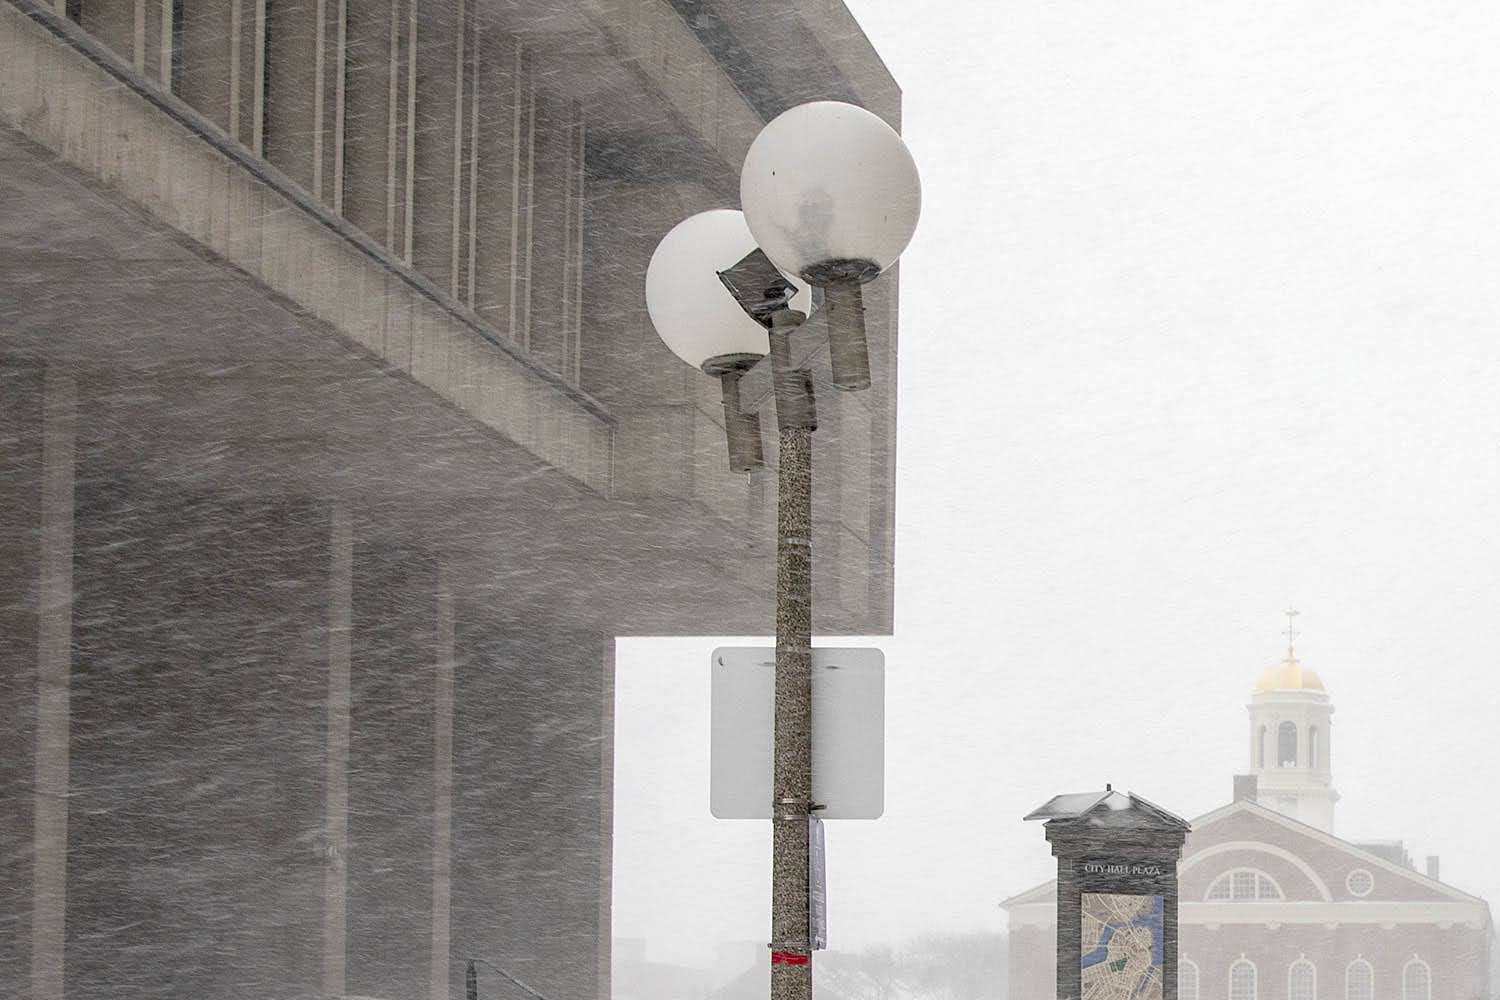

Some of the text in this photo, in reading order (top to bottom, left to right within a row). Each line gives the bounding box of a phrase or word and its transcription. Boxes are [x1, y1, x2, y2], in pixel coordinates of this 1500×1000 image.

[1084, 864, 1161, 875] CITY HALL PLAZA
